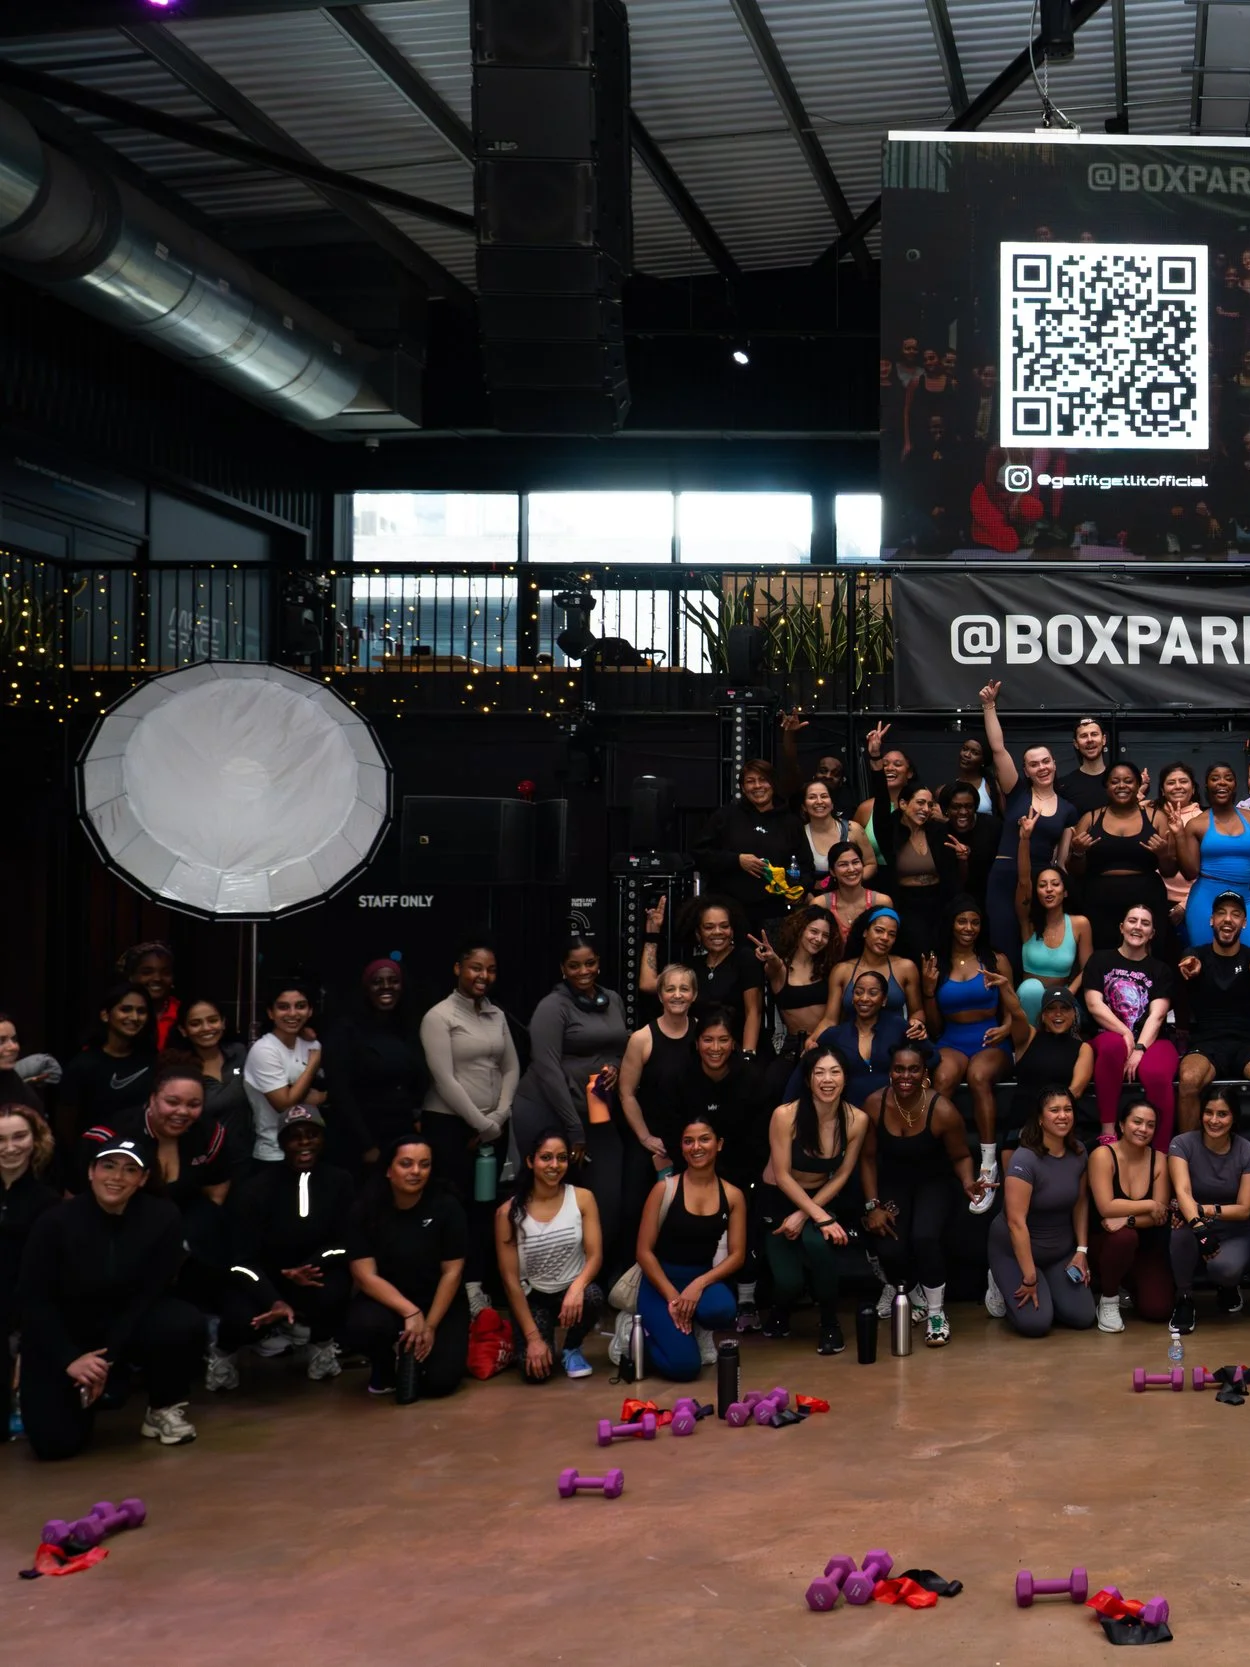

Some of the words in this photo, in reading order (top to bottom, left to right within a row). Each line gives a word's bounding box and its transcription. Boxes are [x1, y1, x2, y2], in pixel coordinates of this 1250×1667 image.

[1036, 473, 1209, 490] @getfitgetlitofficial
[358, 895, 398, 908] STAFF
[400, 895, 434, 908] ONLY
